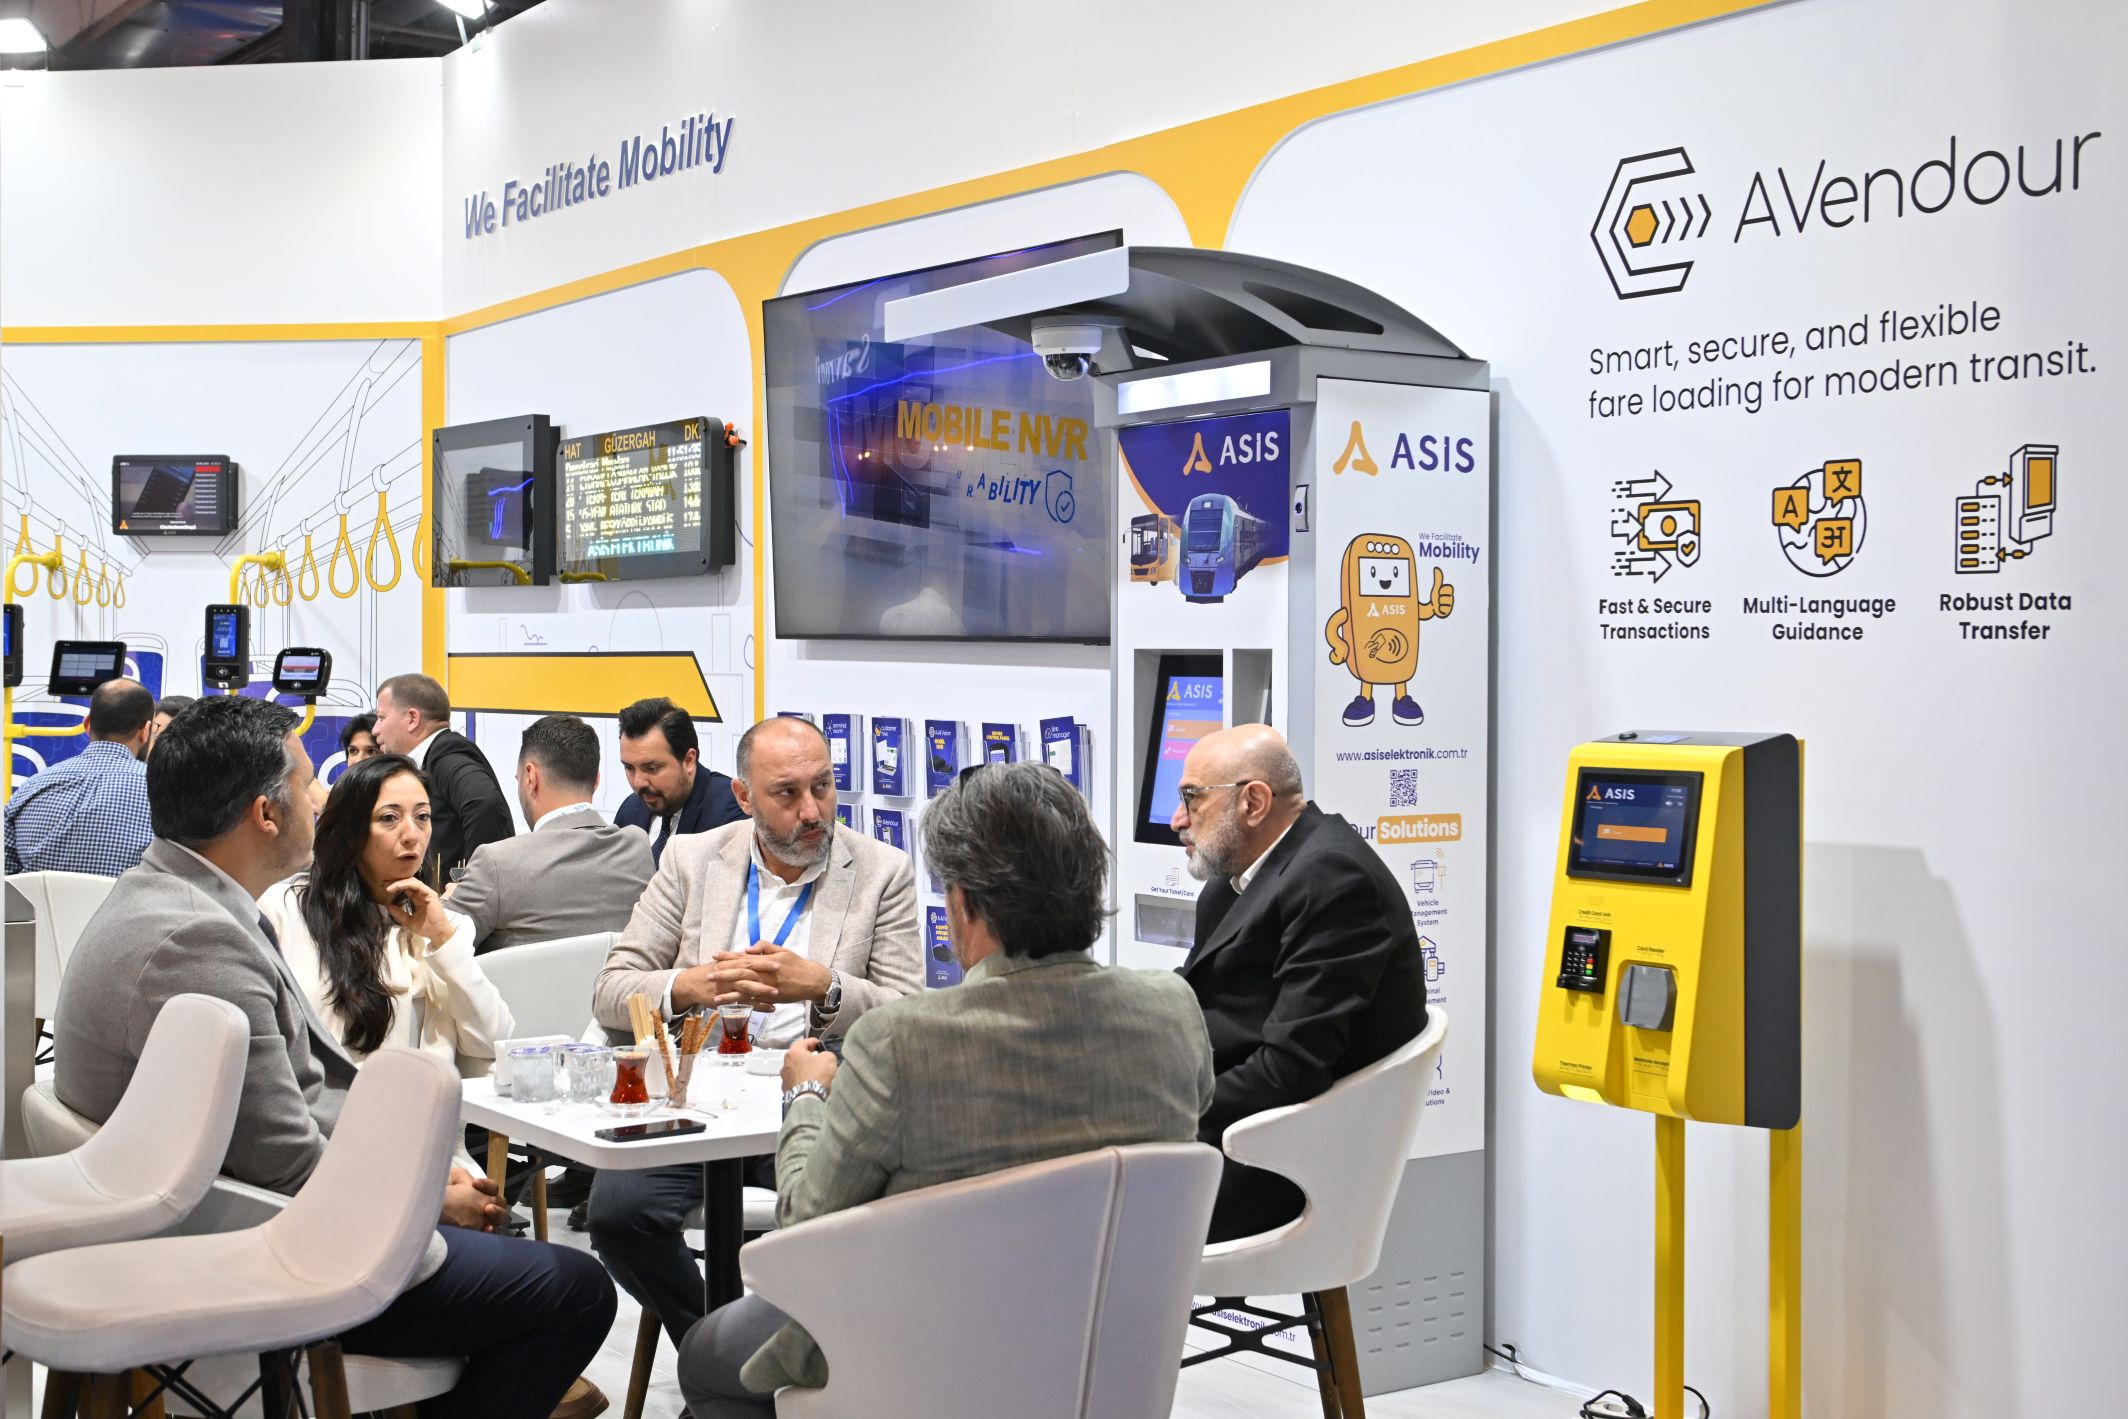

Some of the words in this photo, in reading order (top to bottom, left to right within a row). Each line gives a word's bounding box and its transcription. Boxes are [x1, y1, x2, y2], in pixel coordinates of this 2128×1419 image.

[464, 190, 497, 240] We
[501, 152, 611, 228] Facilitate
[617, 111, 736, 190] Mobility
[1733, 130, 2102, 244] AVendour
[1589, 339, 1680, 376] Smart,
[1687, 327, 1796, 365] secure,
[1805, 314, 1869, 351] and
[1879, 300, 2001, 344] flexible
[1588, 387, 1644, 419] fare
[1651, 375, 1764, 414] loading
[1772, 369, 1815, 403] for
[1824, 359, 1958, 398] modern
[1969, 340, 2098, 383] transit.
[897, 400, 1012, 452] MOBILE
[1017, 411, 1089, 461] NVR
[564, 442, 582, 460] HAT
[604, 430, 656, 454] GÜZERGAH
[1218, 431, 1280, 466] ASIS
[1390, 432, 1475, 474] ASIS
[1418, 532, 1430, 541] We
[1431, 532, 1463, 542] Facilitate
[1419, 541, 1480, 565] Mobility
[1382, 604, 1406, 616] ASIS
[1598, 598, 1635, 615] Fast
[1637, 598, 1650, 614] &
[1653, 597, 1712, 615] Secure
[1743, 596, 1897, 619] Multi-Language
[1939, 592, 2015, 612] Robust
[2019, 592, 2073, 612] Data
[1600, 622, 1711, 641] Transactions
[1772, 622, 1864, 641] Guidance
[1958, 621, 2051, 641] Transfer
[1183, 683, 1213, 699] ASIS
[1336, 748, 1468, 762] www.asiselektronik.com.tr
[1604, 788, 1636, 800] ASIS
[1379, 818, 1459, 840] Solutions
[1416, 899, 1439, 907] Vehicle
[1416, 919, 1439, 928] System
